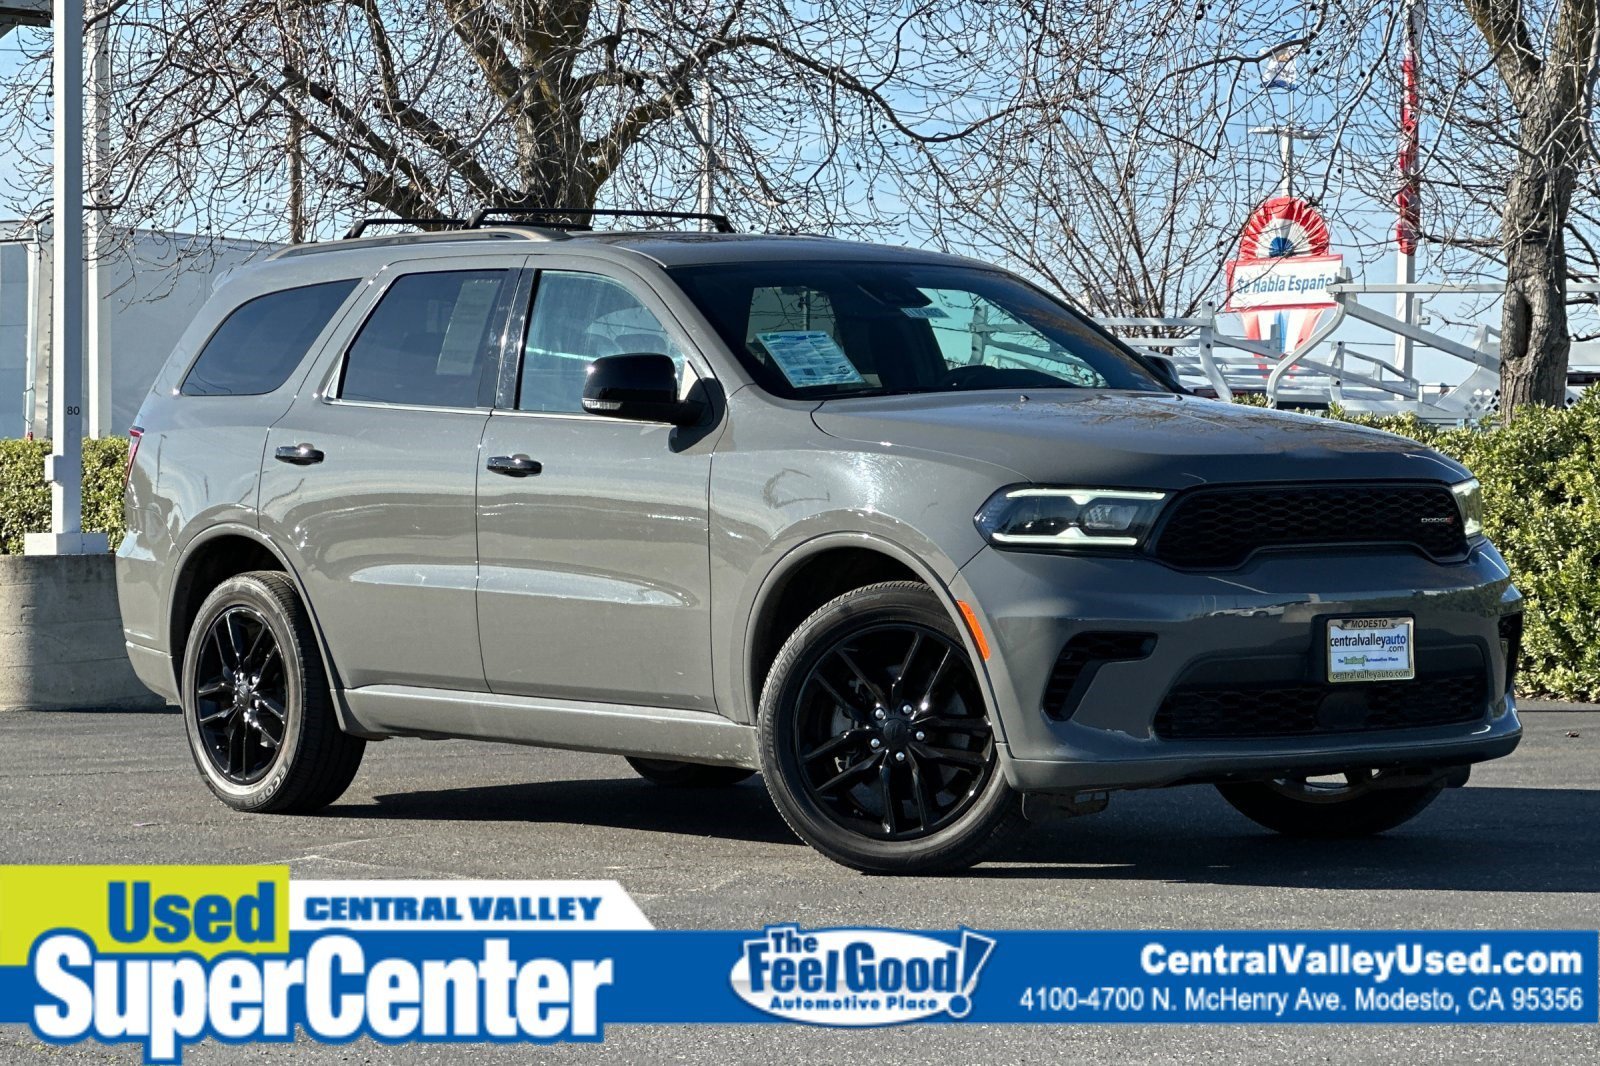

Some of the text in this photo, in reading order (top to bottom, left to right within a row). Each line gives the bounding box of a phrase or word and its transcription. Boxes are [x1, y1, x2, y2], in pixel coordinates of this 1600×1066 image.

[1252, 274, 1285, 293] Habla
[66, 406, 80, 415] 80
[1351, 620, 1388, 628] MODESTO
[1330, 633, 1406, 649] centralvalleyauto
[1386, 645, 1404, 653] .com
[1332, 670, 1409, 680] centralvalleyauto.com
